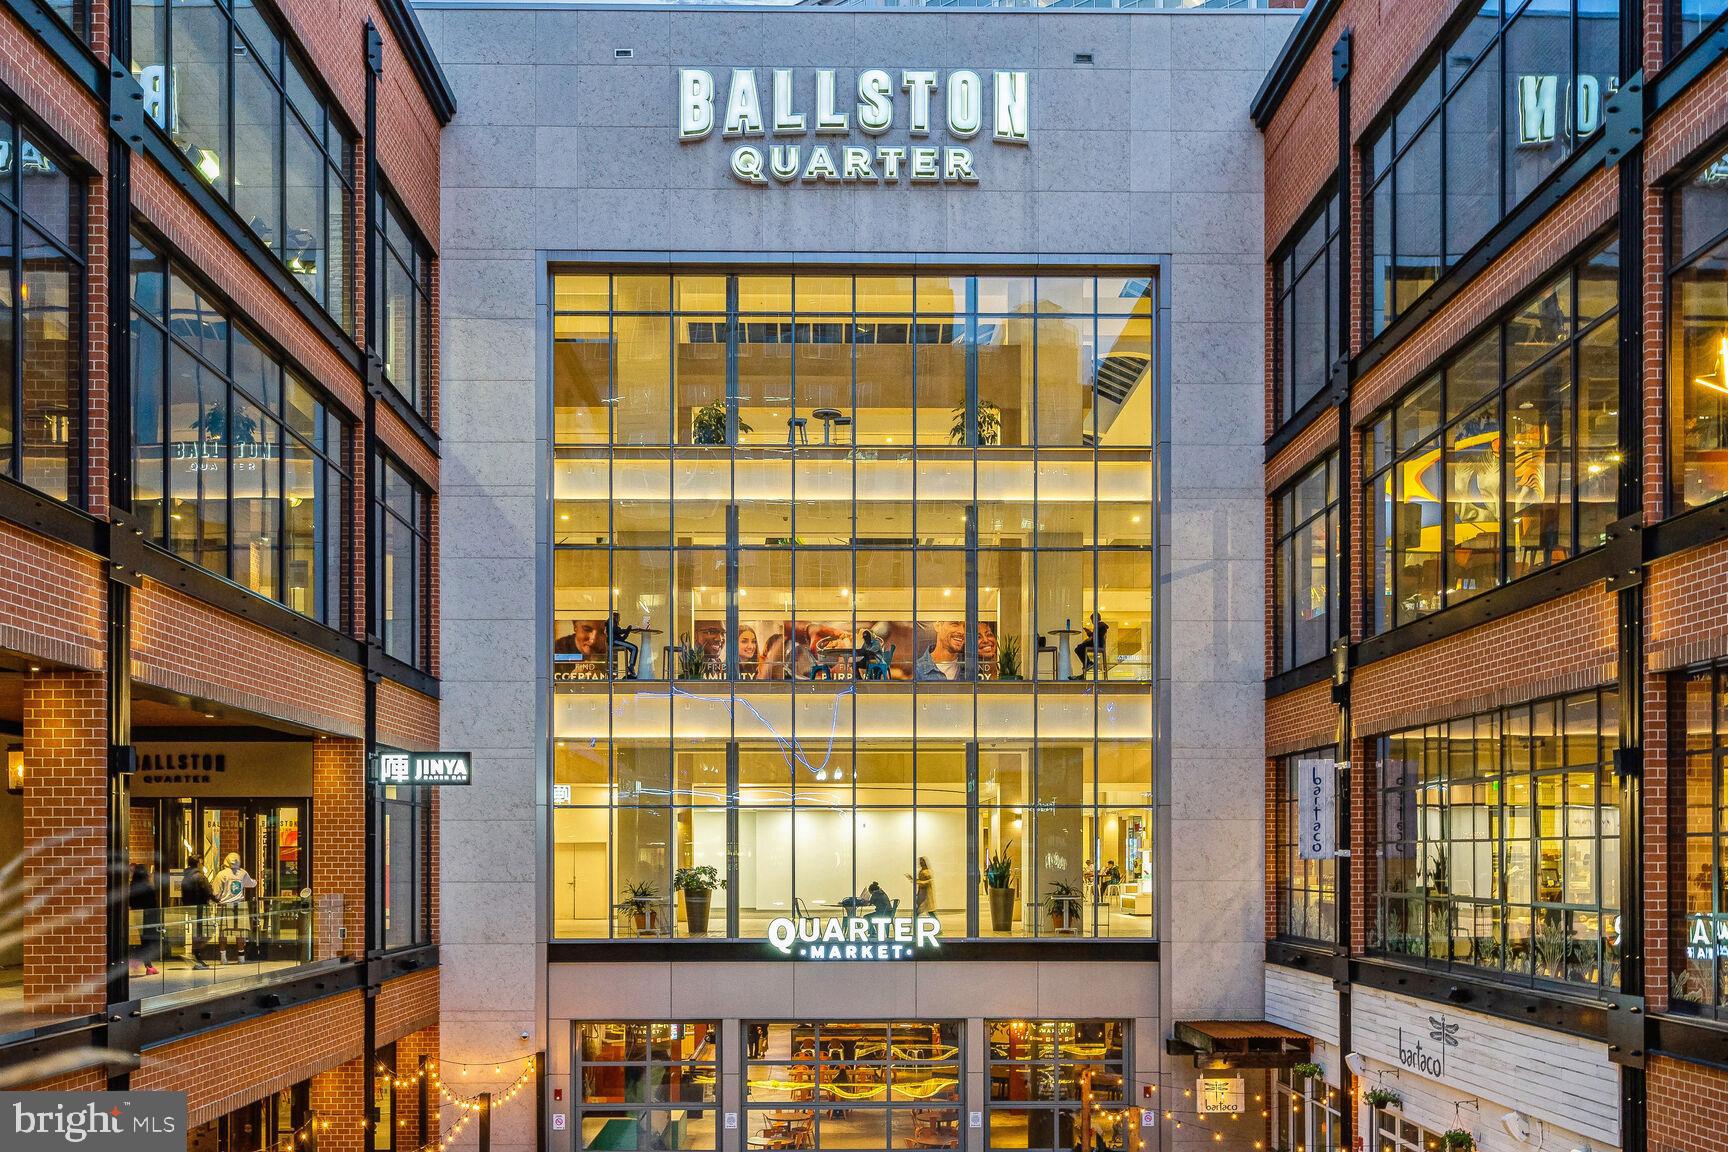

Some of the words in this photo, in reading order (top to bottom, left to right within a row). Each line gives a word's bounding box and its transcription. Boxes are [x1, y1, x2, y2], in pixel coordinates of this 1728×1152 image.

[678, 68, 1030, 144] BALLSTON
[729, 145, 980, 184] QUARTER
[174, 441, 272, 460] BALLTON
[136, 754, 225, 772] ALLSTON
[415, 759, 468, 780] JINYA
[143, 774, 211, 784] QUARTER
[1312, 767, 1322, 852] bartaco
[767, 917, 941, 953] QUARTER
[811, 945, 904, 959] MARKET
[1399, 1027, 1441, 1078] bartaco
[1205, 1099, 1238, 1111] bartaco
